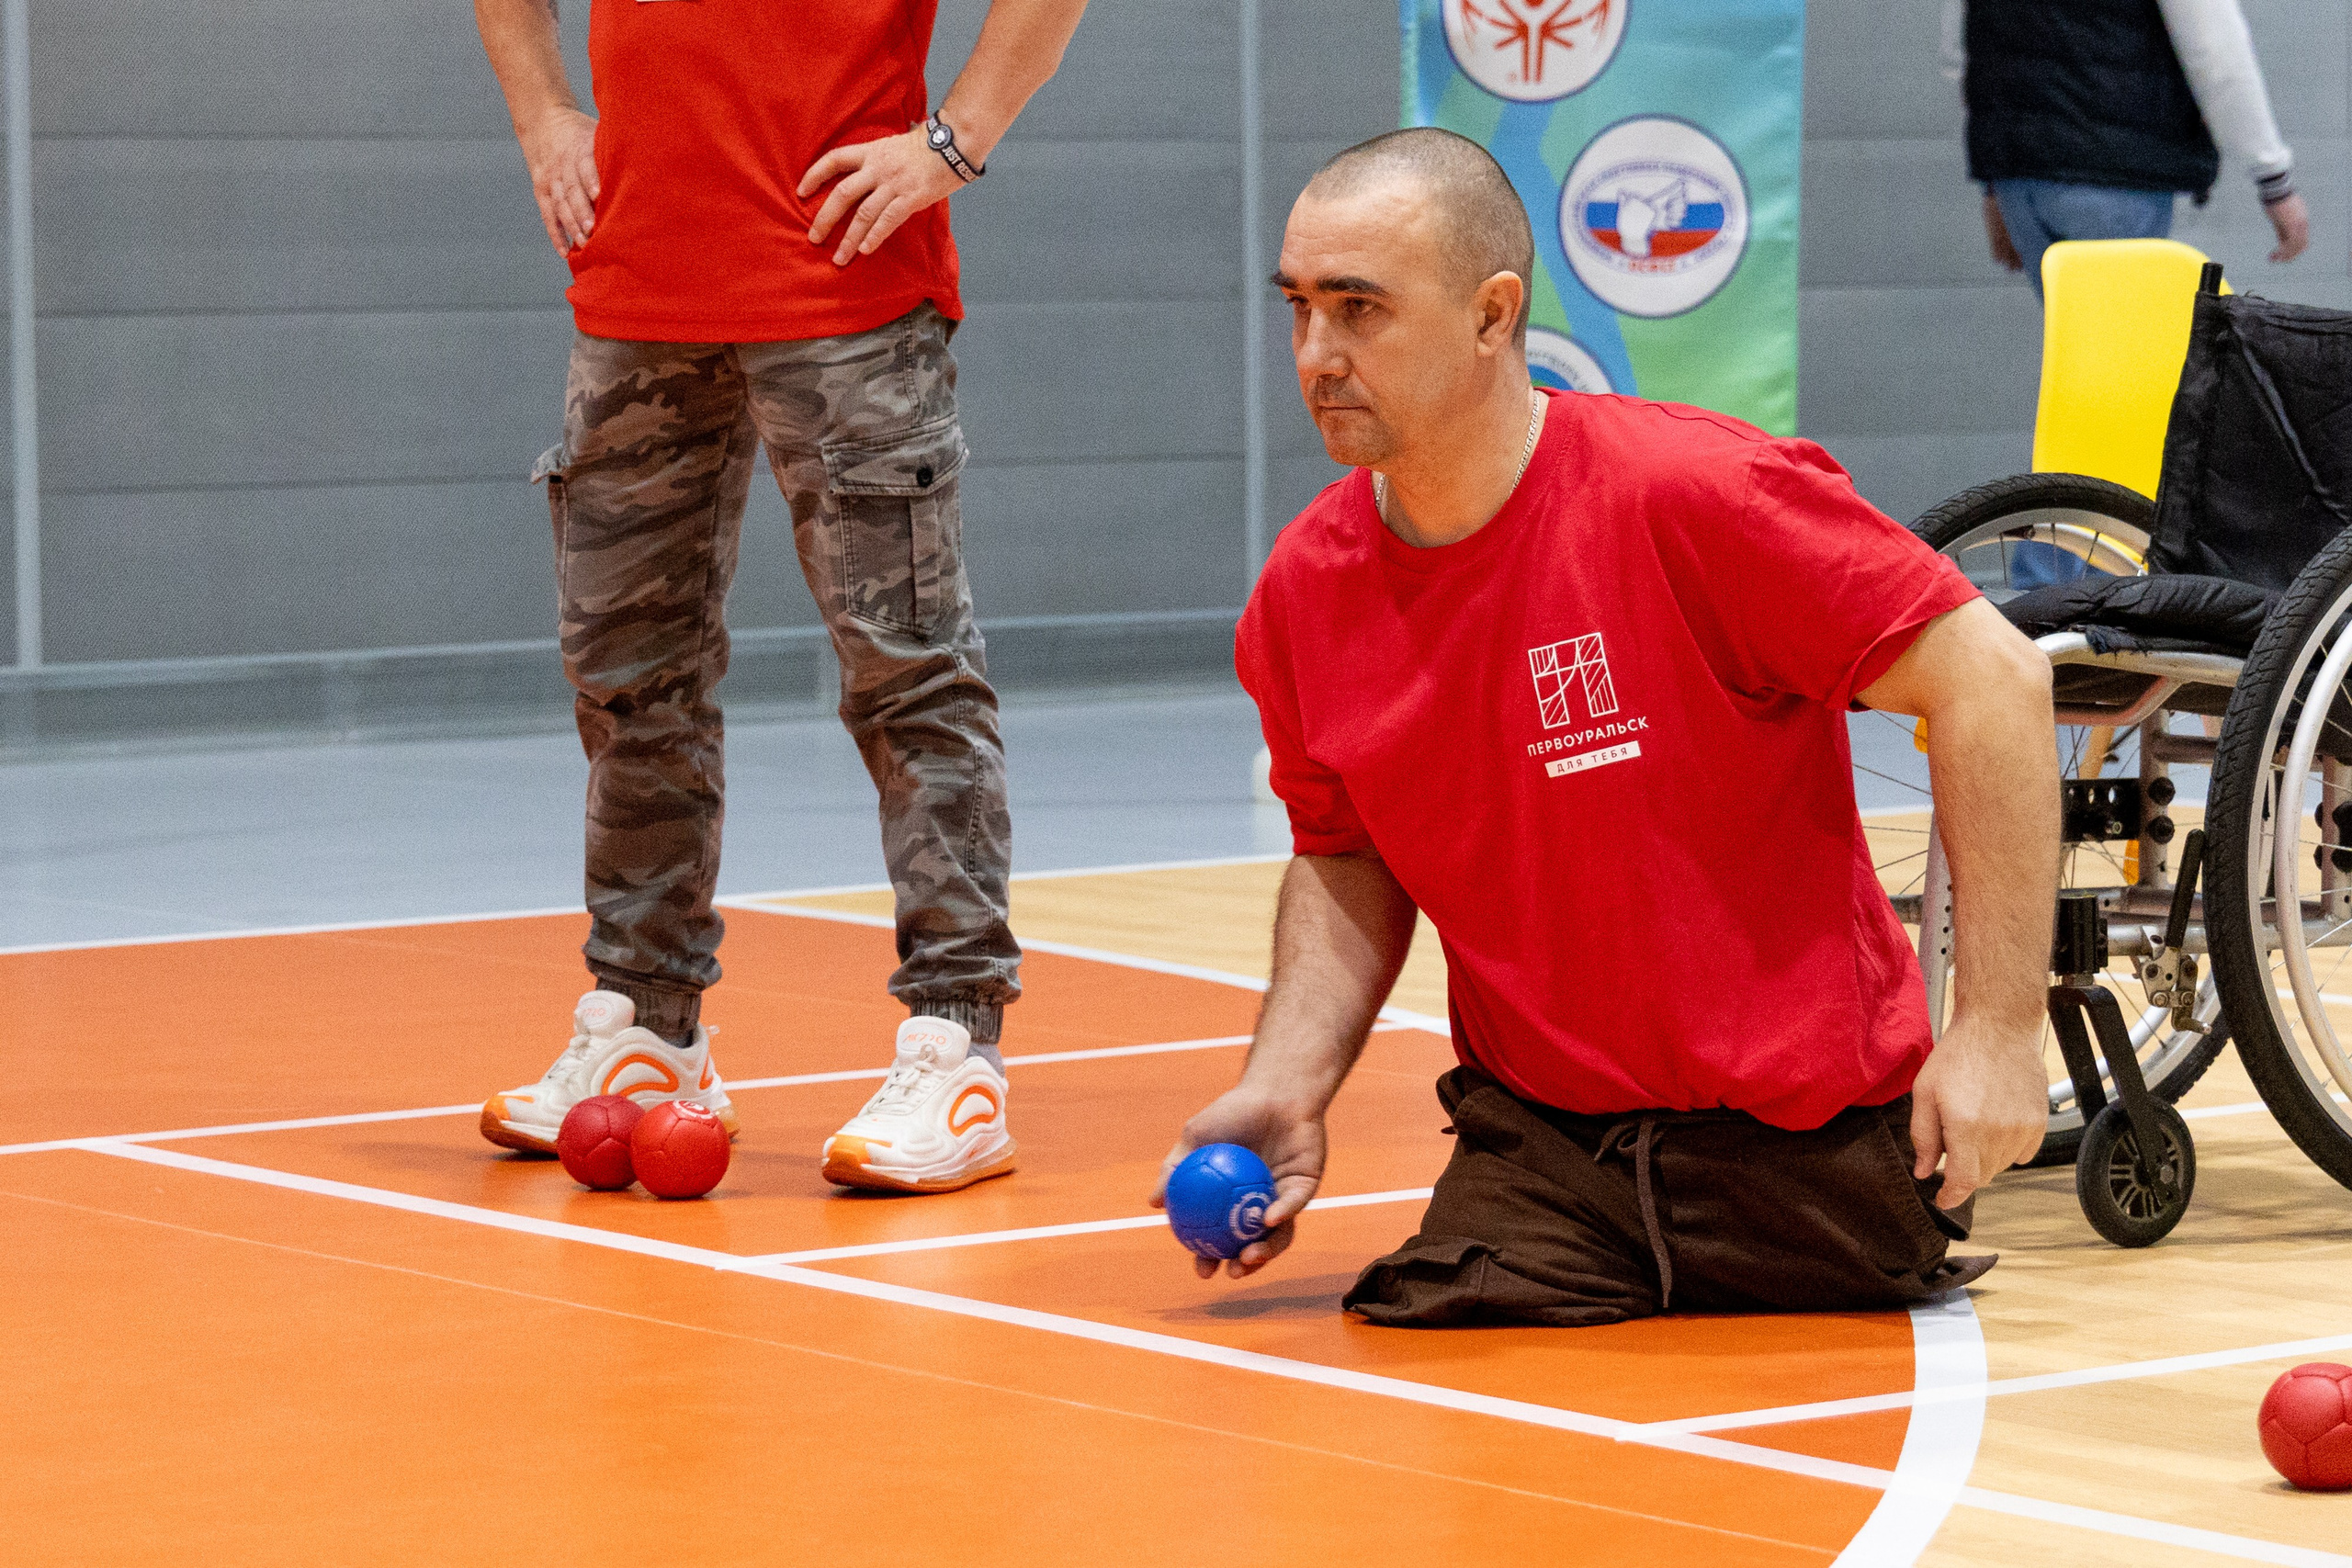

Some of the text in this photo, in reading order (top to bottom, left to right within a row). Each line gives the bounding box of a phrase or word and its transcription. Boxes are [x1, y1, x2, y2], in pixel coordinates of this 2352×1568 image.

[942, 146, 961, 164] JUST
[1527, 716, 1649, 757] ПЕРВОУРАЛЬСК
[1556, 747, 1628, 773] ДЛЯ ТЕБЯ
